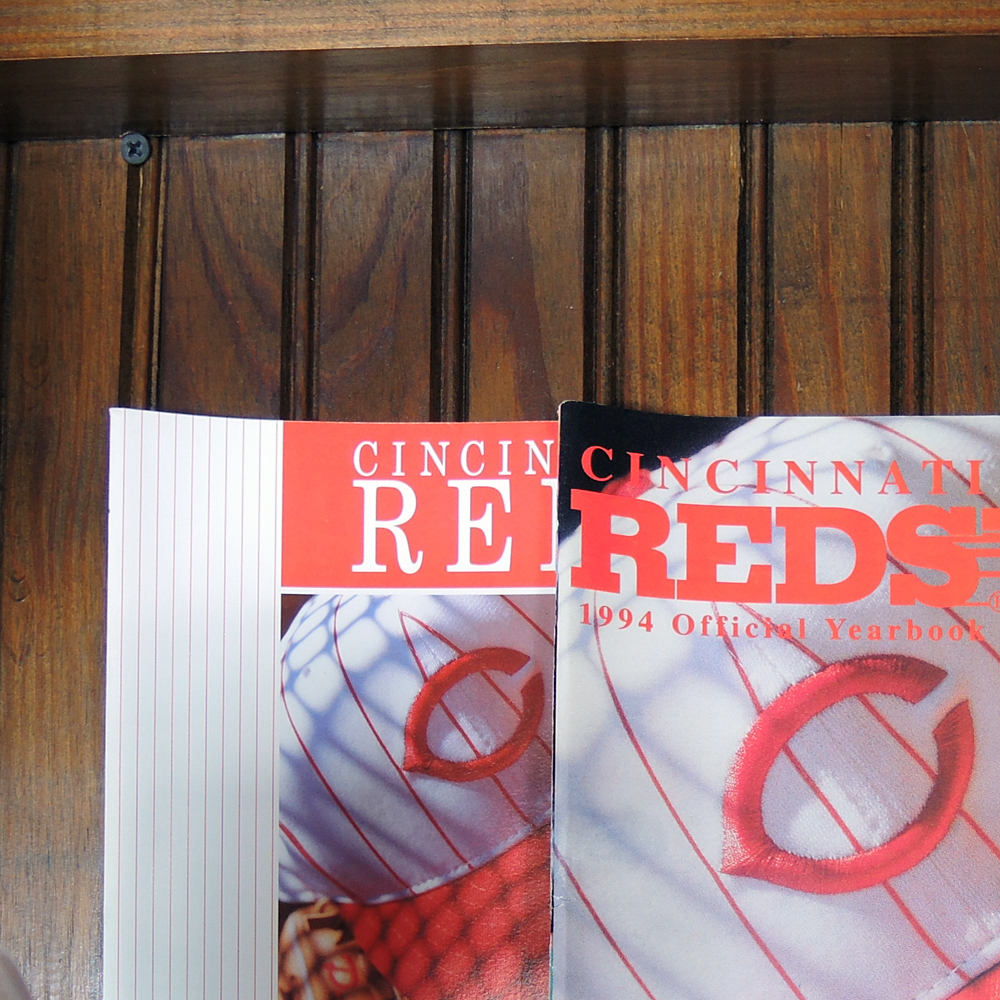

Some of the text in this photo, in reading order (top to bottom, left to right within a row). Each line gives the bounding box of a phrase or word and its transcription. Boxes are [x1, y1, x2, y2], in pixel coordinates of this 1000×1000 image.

[353, 439, 555, 477] CINCIN
[580, 444, 986, 496] CINCINNATI
[570, 488, 982, 609] REDS
[578, 602, 987, 642] 1994 Official Yearbook
